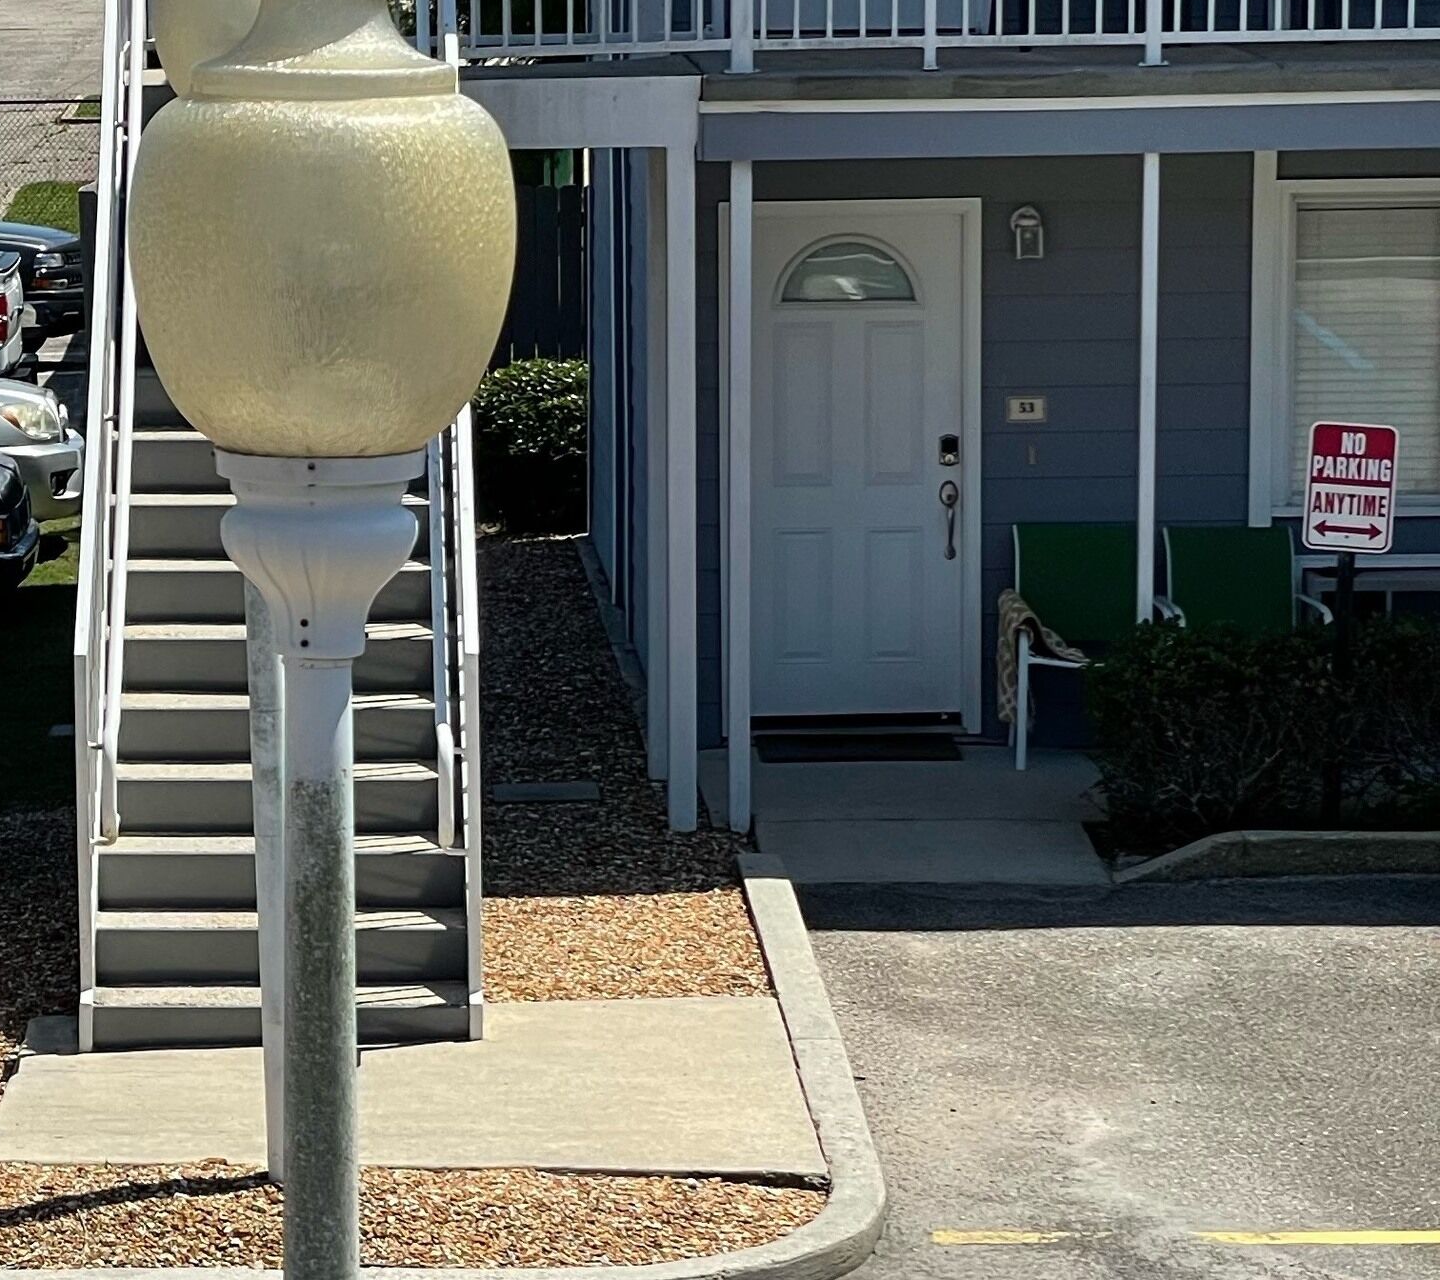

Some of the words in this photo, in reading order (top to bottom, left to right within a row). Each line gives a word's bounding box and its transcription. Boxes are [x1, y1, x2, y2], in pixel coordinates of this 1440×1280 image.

[1018, 402, 1035, 413] 53
[1340, 432, 1366, 455] NO
[1312, 455, 1392, 482] PARKING
[1312, 491, 1387, 518] ANYTIME
